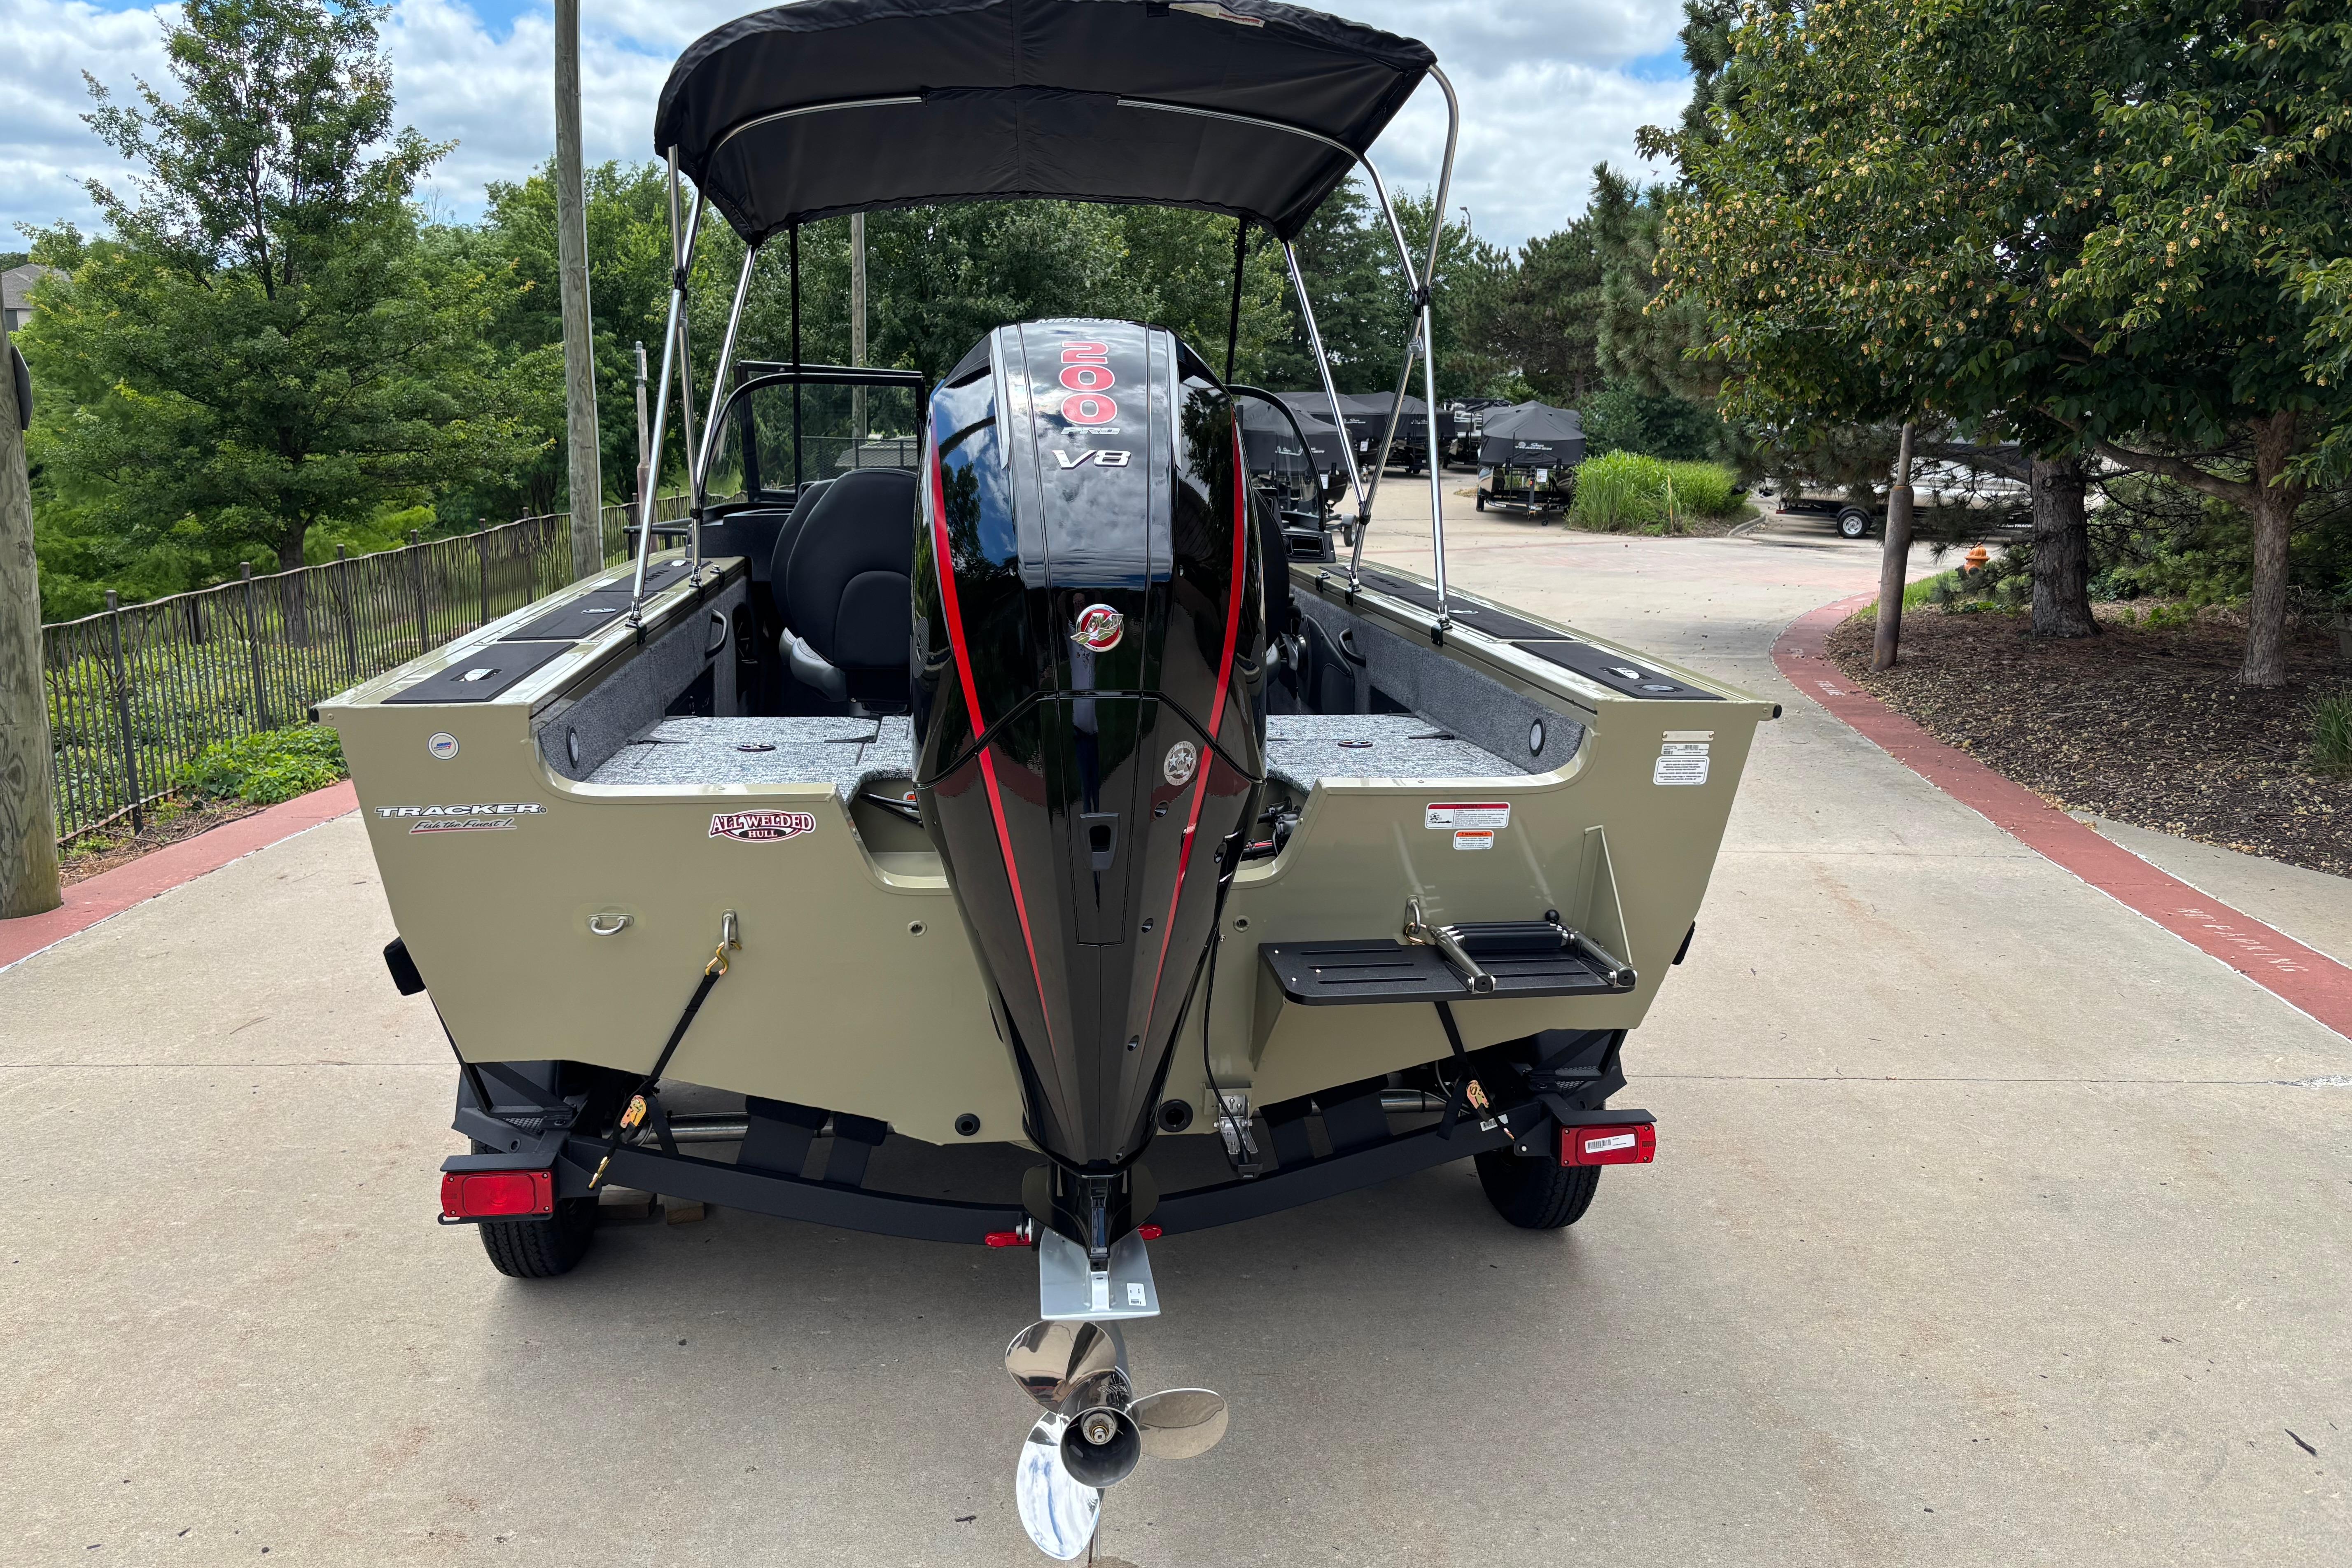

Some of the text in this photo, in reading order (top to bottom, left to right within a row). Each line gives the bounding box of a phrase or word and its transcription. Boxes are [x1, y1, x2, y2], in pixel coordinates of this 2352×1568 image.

[1059, 341, 1118, 425] 200
[1052, 450, 1132, 469] V8
[376, 803, 541, 817] TRACKER
[2202, 924, 2309, 972] PARKING
